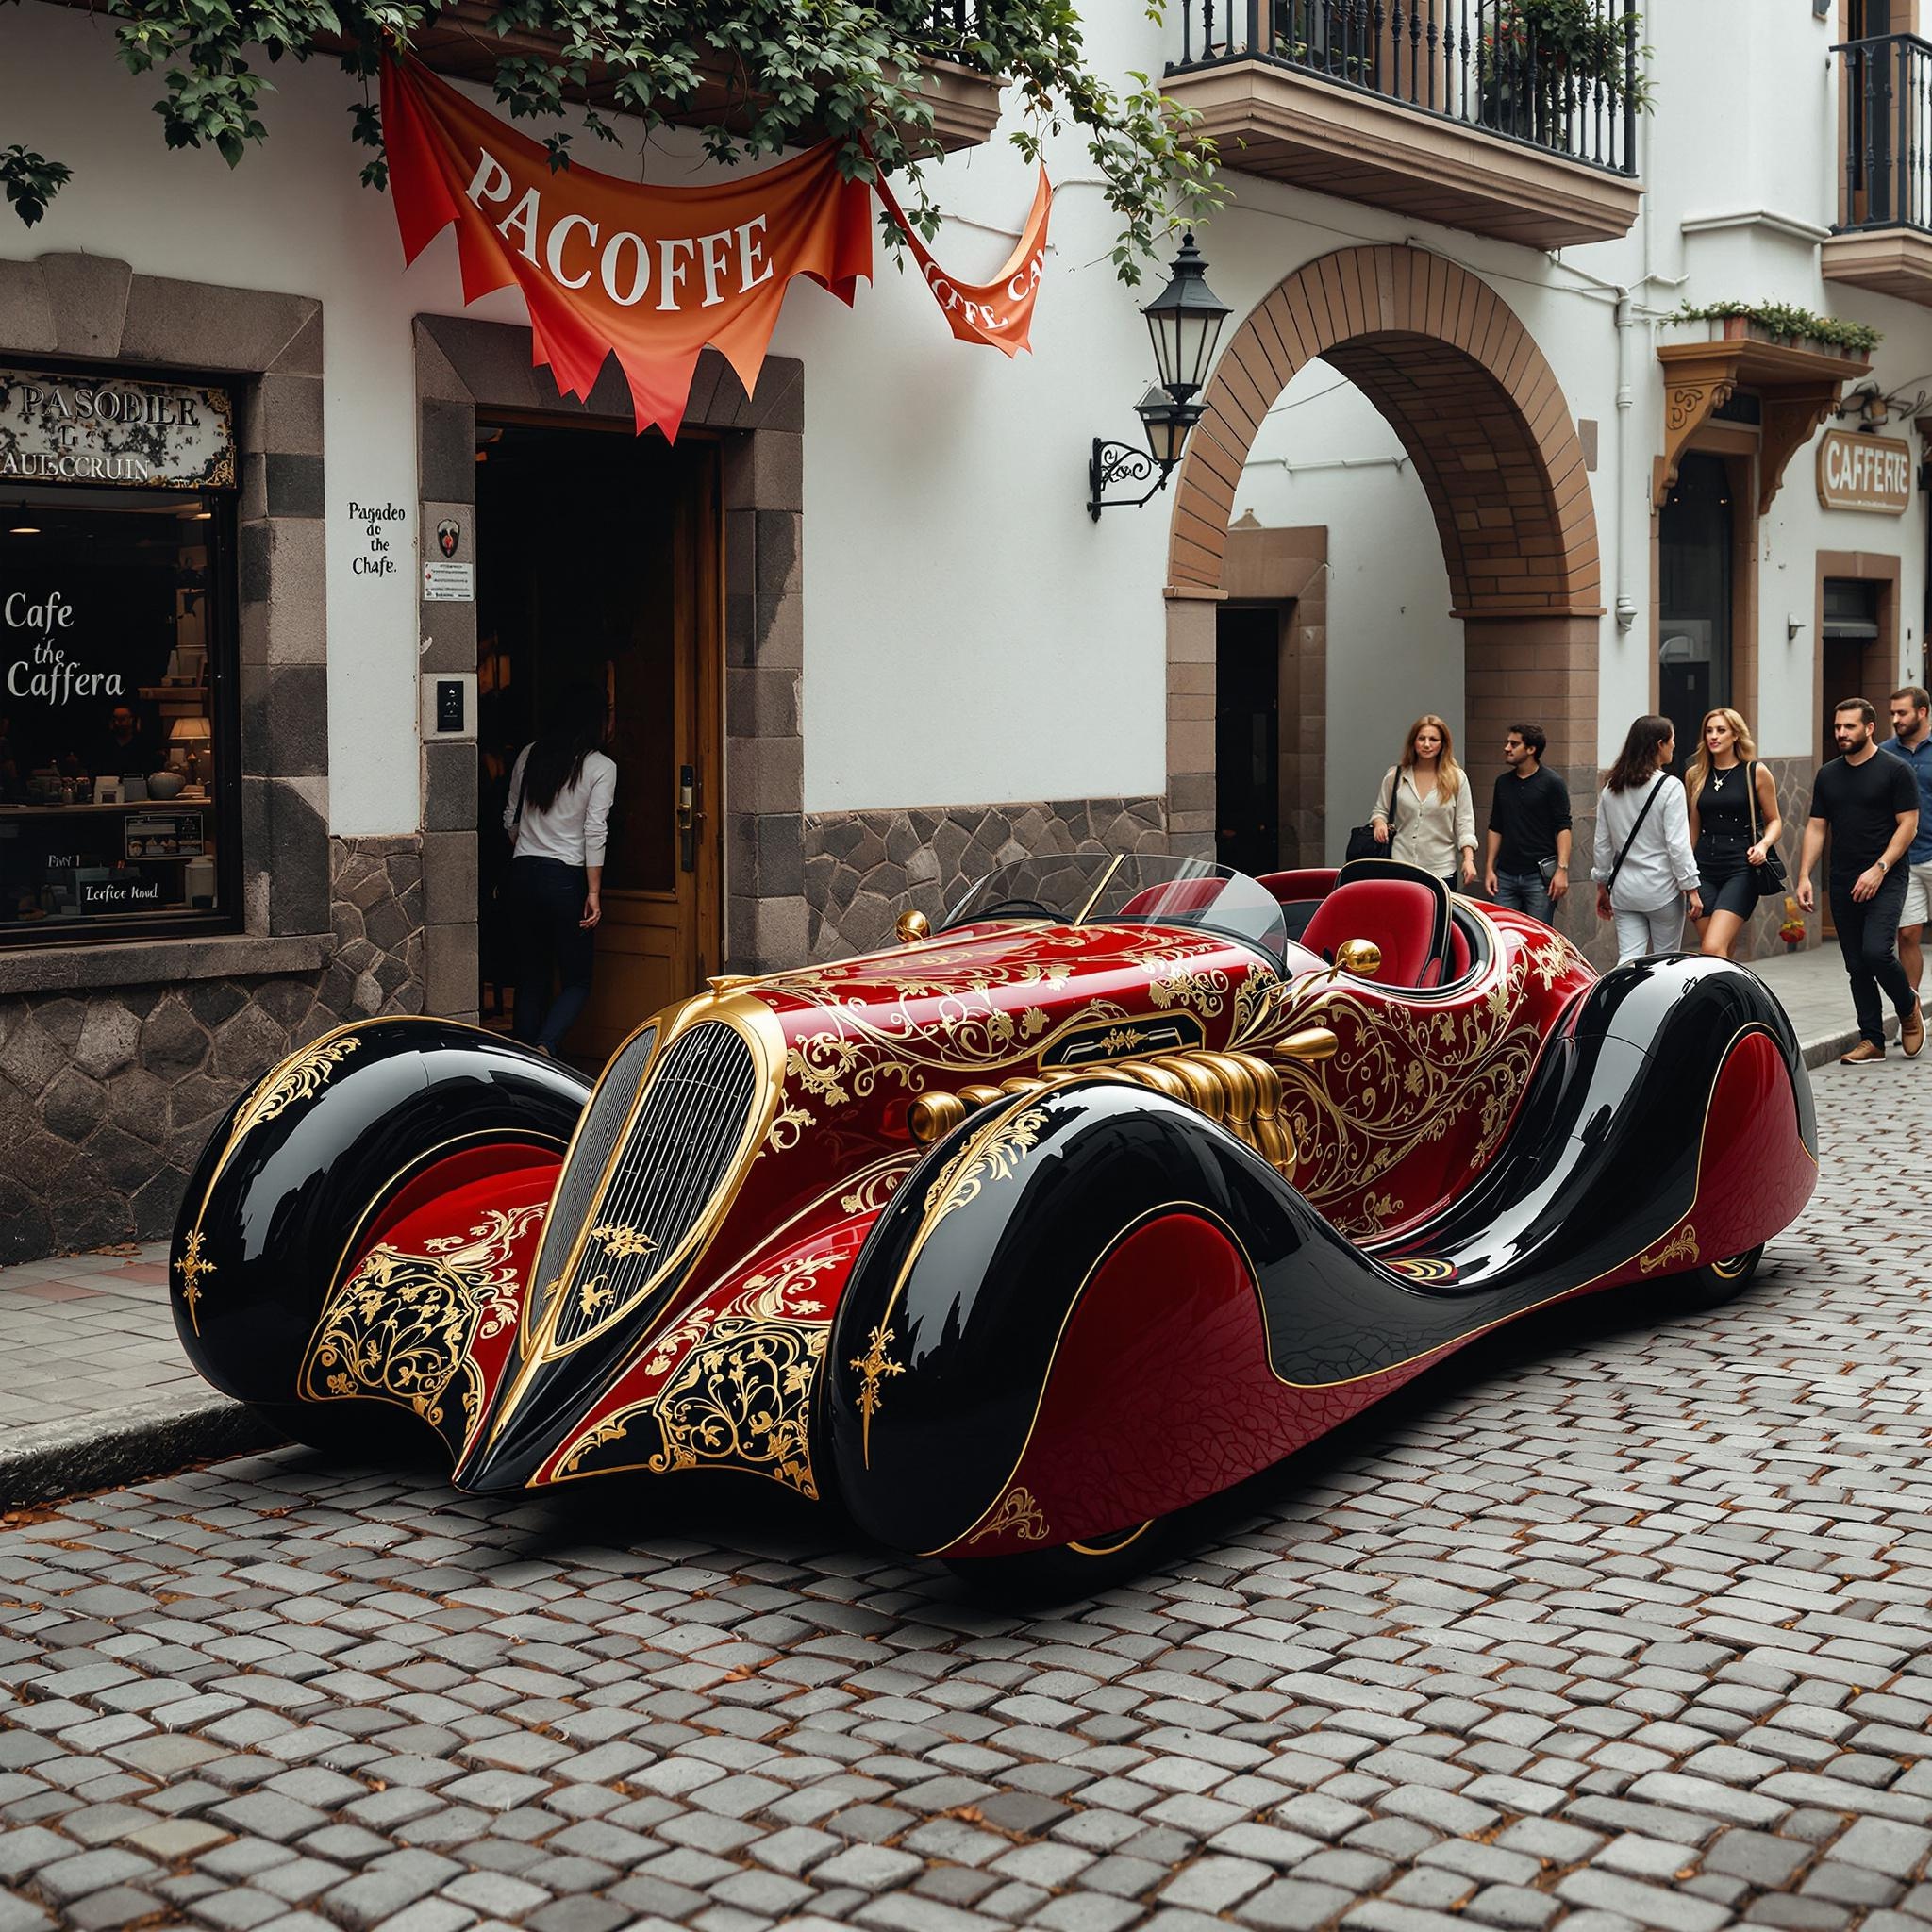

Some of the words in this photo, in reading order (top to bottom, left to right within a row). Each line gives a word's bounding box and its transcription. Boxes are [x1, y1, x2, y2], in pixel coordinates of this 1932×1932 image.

[465, 146, 774, 310] PACOFFE
[370, 538, 390, 552] the
[4, 591, 75, 635] Cafe
[33, 637, 65, 664] the
[7, 660, 126, 706] Caffera
